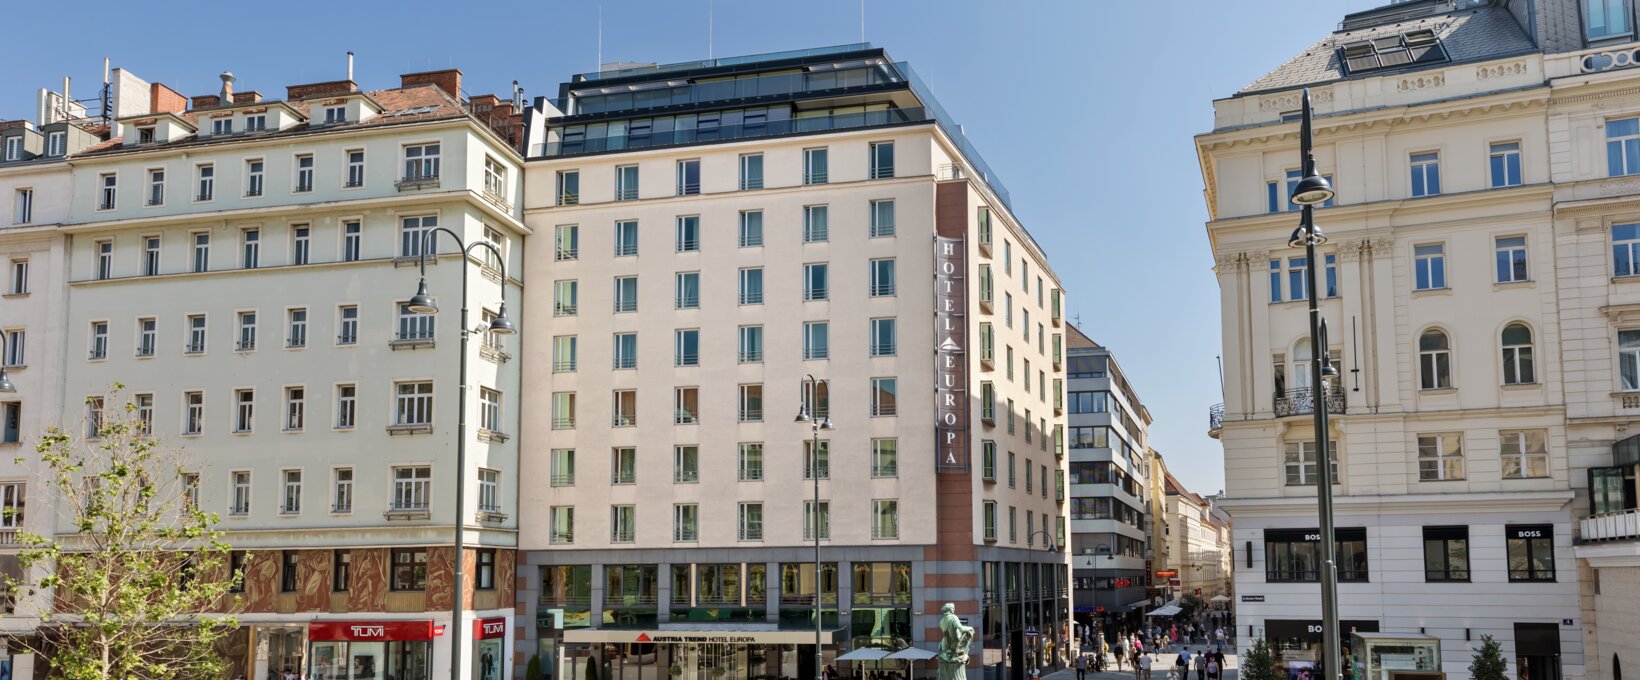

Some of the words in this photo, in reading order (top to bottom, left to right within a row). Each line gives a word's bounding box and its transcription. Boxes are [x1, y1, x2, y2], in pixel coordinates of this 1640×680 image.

[943, 243, 955, 331] HOTEL
[945, 355, 957, 464] EUROPA
[351, 625, 384, 637] TUMI
[483, 622, 504, 634] TUMI
